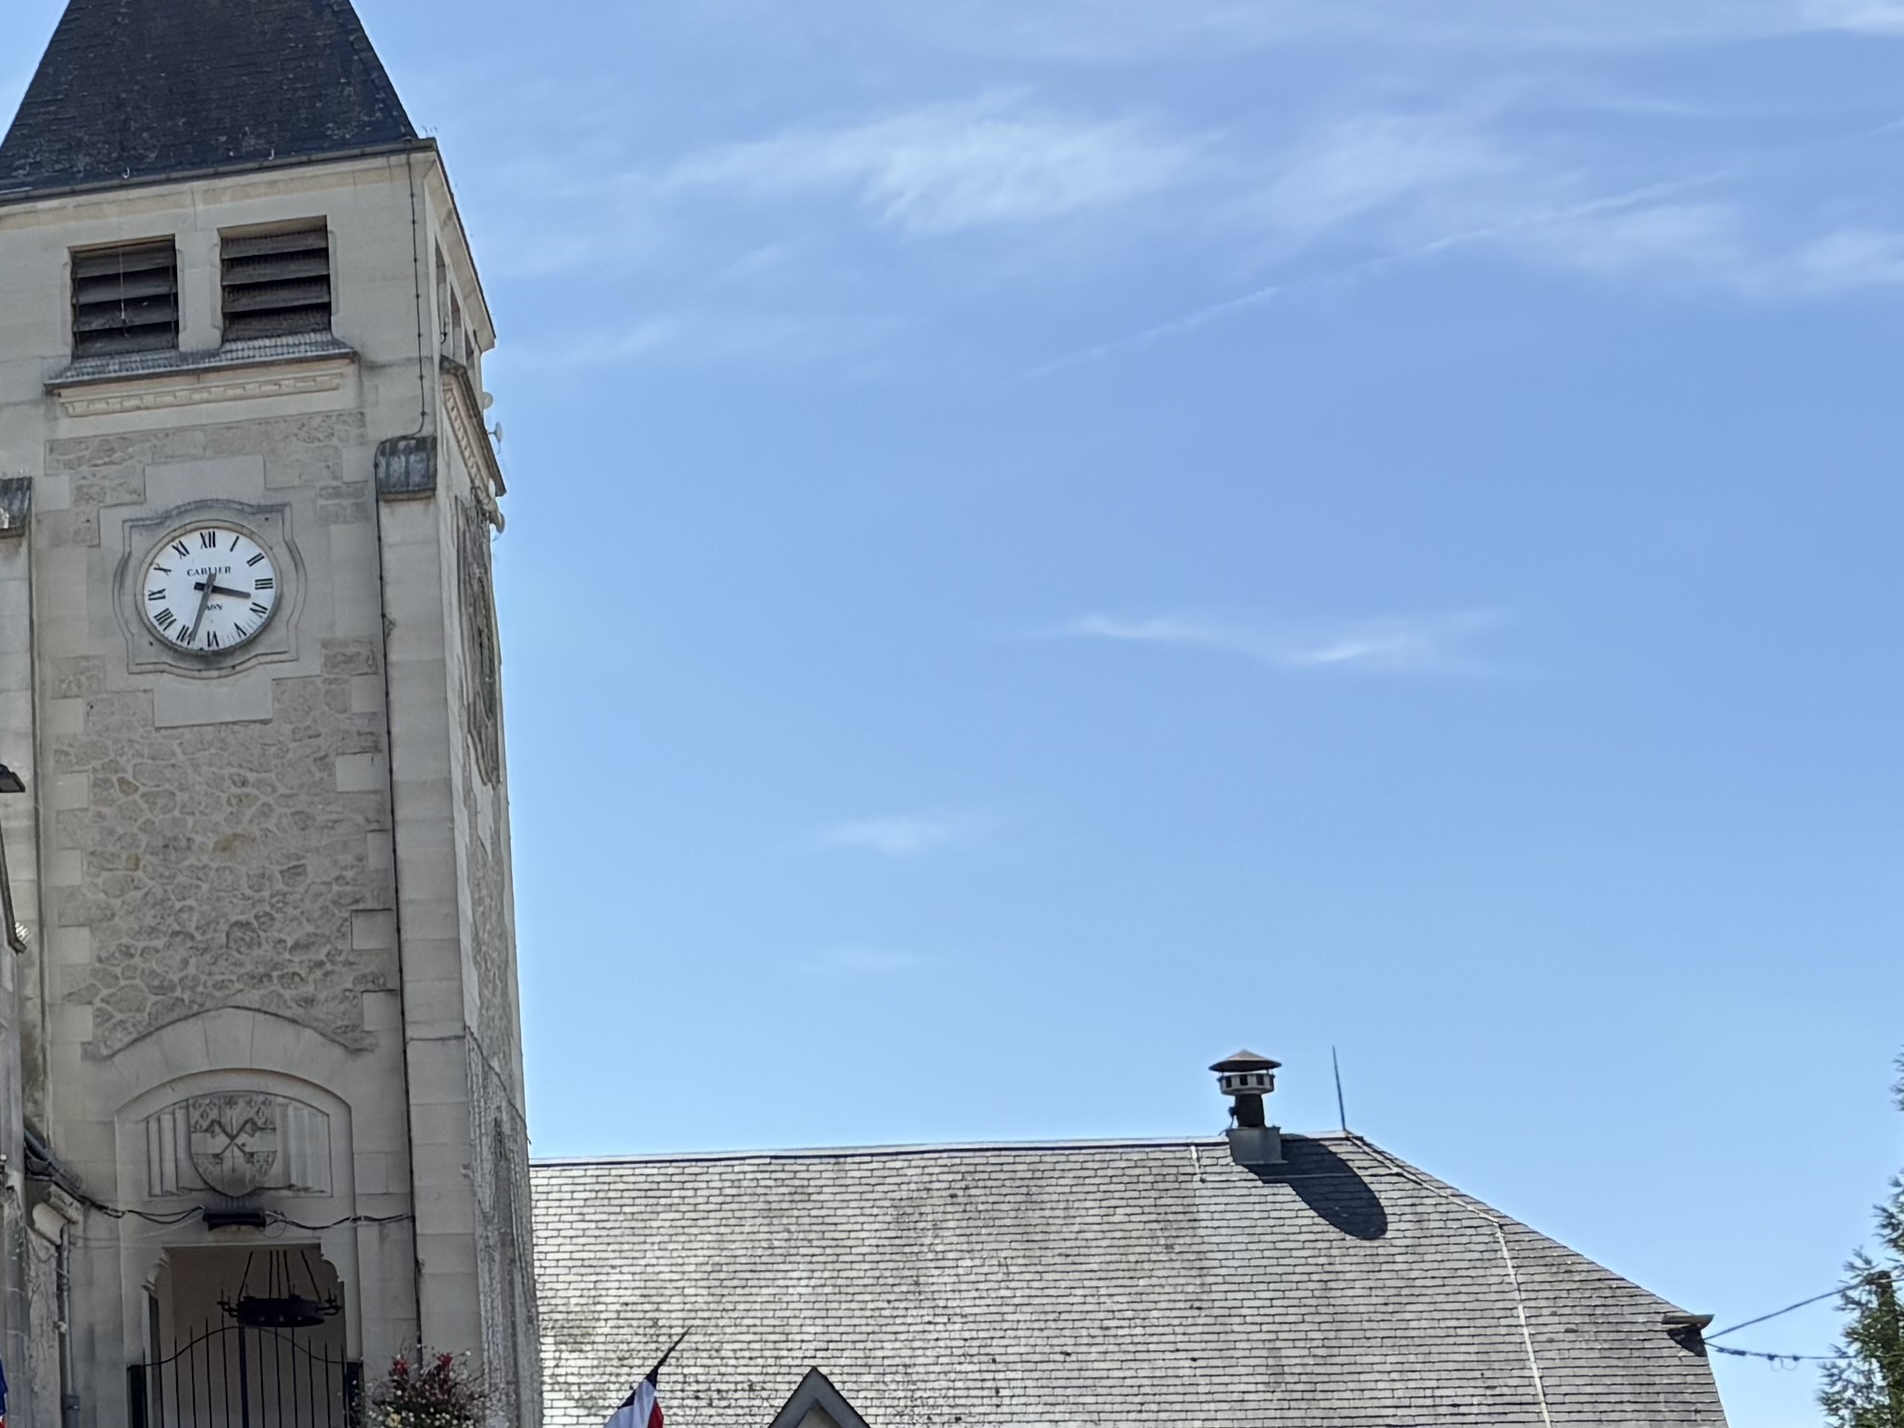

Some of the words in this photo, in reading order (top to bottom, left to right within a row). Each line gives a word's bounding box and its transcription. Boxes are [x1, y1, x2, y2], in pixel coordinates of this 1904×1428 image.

[199, 531, 216, 549] XII
[172, 540, 190, 559] XI
[246, 552, 265, 567] II
[153, 563, 172, 576] X
[254, 578, 274, 590] III
